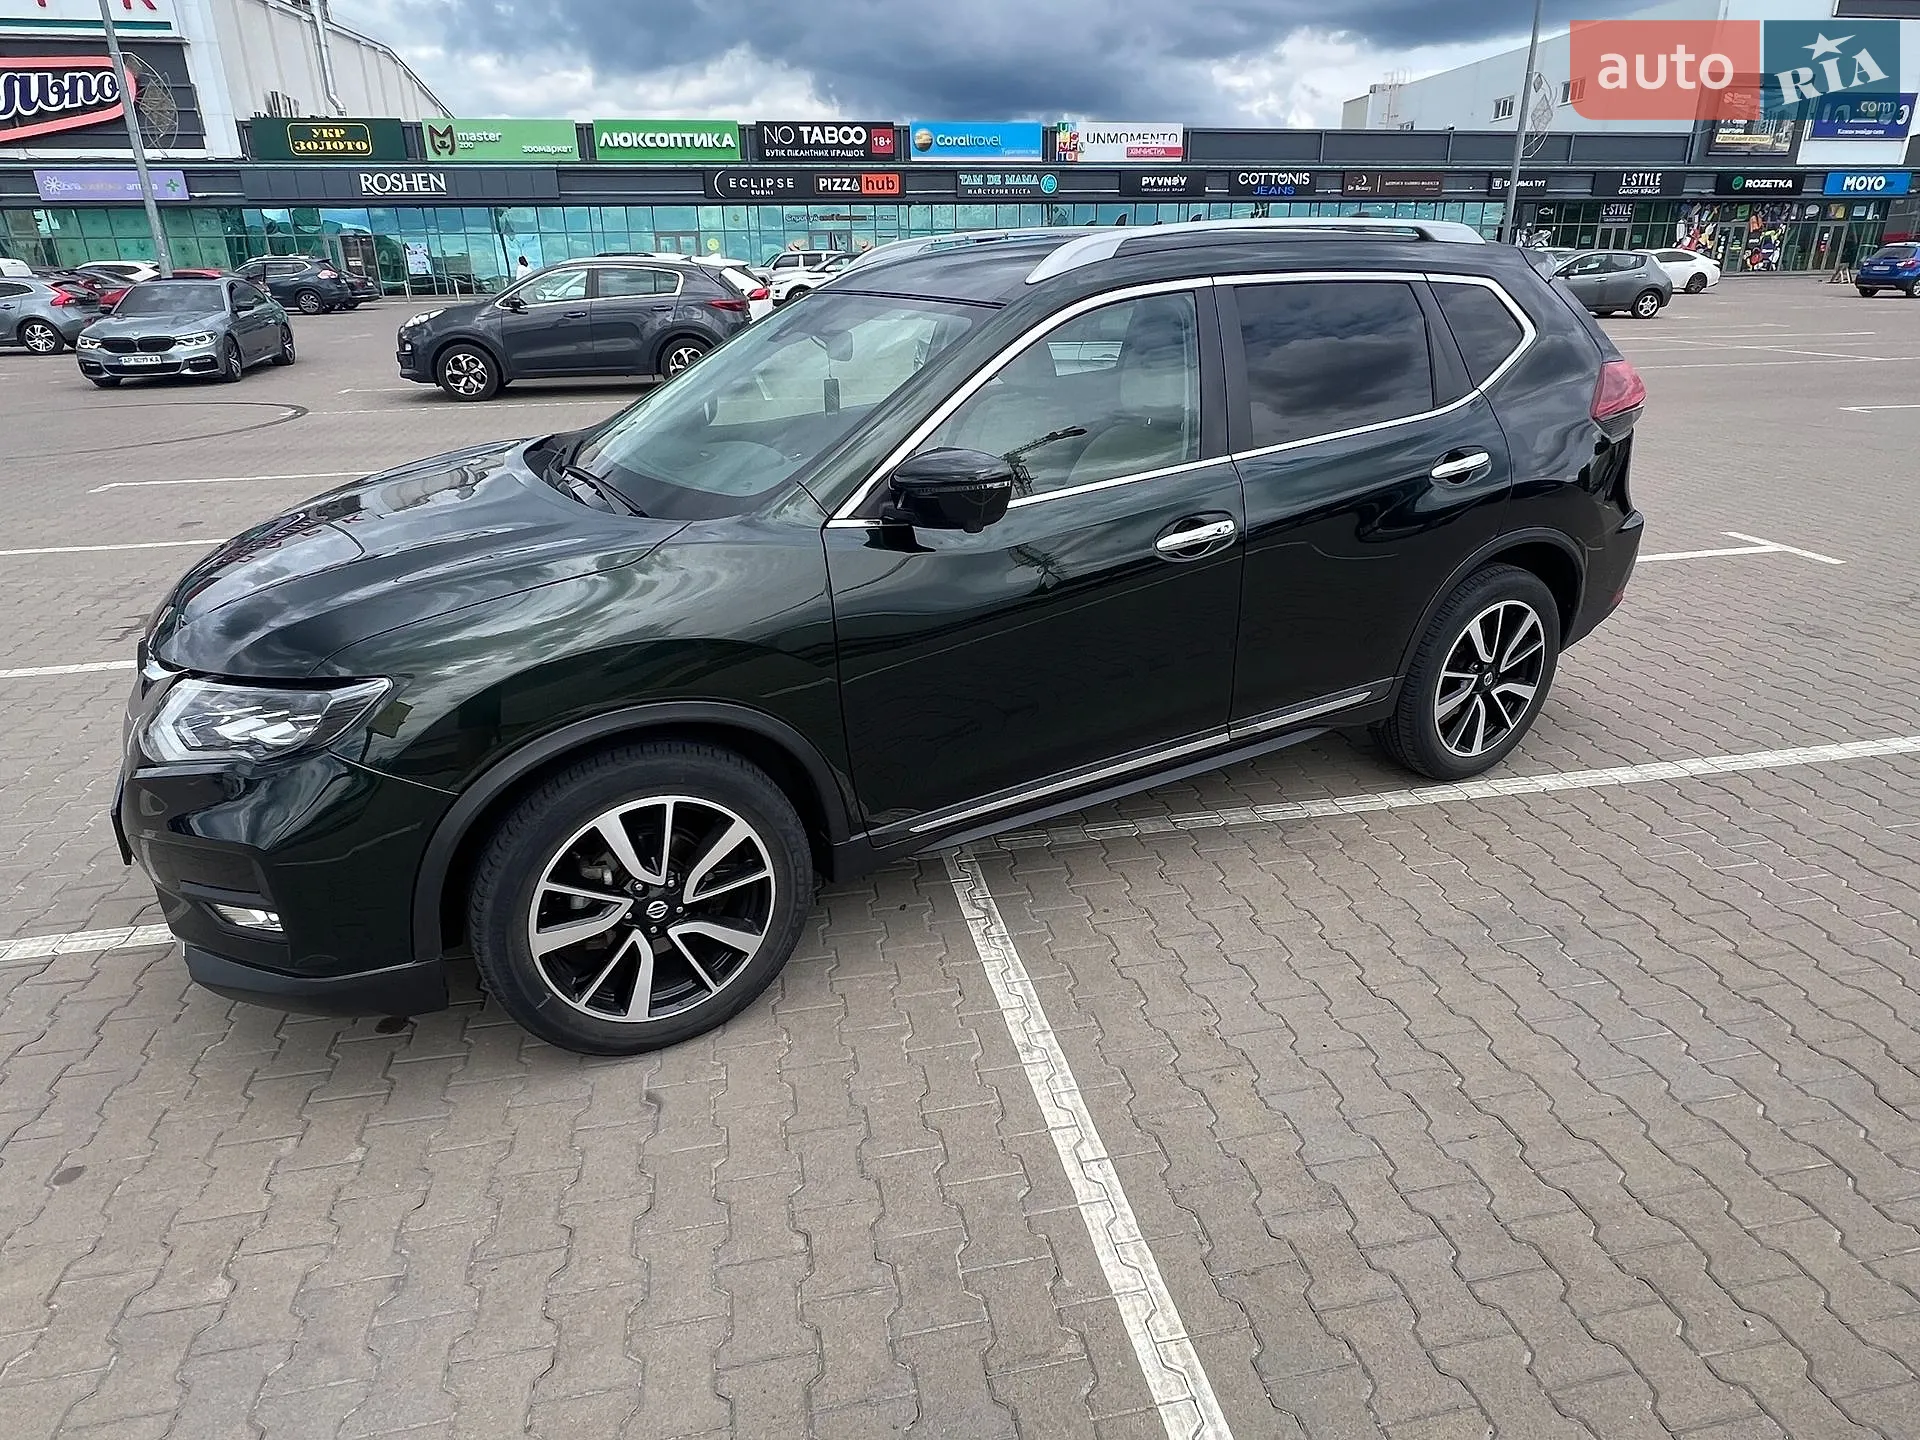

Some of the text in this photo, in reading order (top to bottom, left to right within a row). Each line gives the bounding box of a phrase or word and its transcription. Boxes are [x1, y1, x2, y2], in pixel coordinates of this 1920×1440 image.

[311, 128, 346, 138] УКР
[457, 131, 501, 141] master
[763, 125, 867, 145] NO TABOO
[1086, 132, 1178, 144] UNMOMENTO
[294, 140, 368, 150] ЗОЛОТО
[600, 131, 736, 148] ЛЮКСОПТИКА
[873, 136, 891, 147] 18+
[522, 145, 573, 154] зоомаркет
[787, 149, 829, 157] ПІКАНТНИХ
[830, 149, 865, 157] ІГРАШОК
[359, 173, 447, 195] ROSHEN
[728, 178, 795, 188] ECLIPSE
[818, 176, 895, 191] PIZZA hub
[1238, 172, 1310, 185] COTTONIS
[1621, 172, 1662, 186] L-STYLE
[1745, 179, 1793, 188] ROZETKA
[1842, 176, 1886, 190] MOYO
[1252, 186, 1296, 195] JEANS
[1602, 203, 1633, 215] L-STYLE
